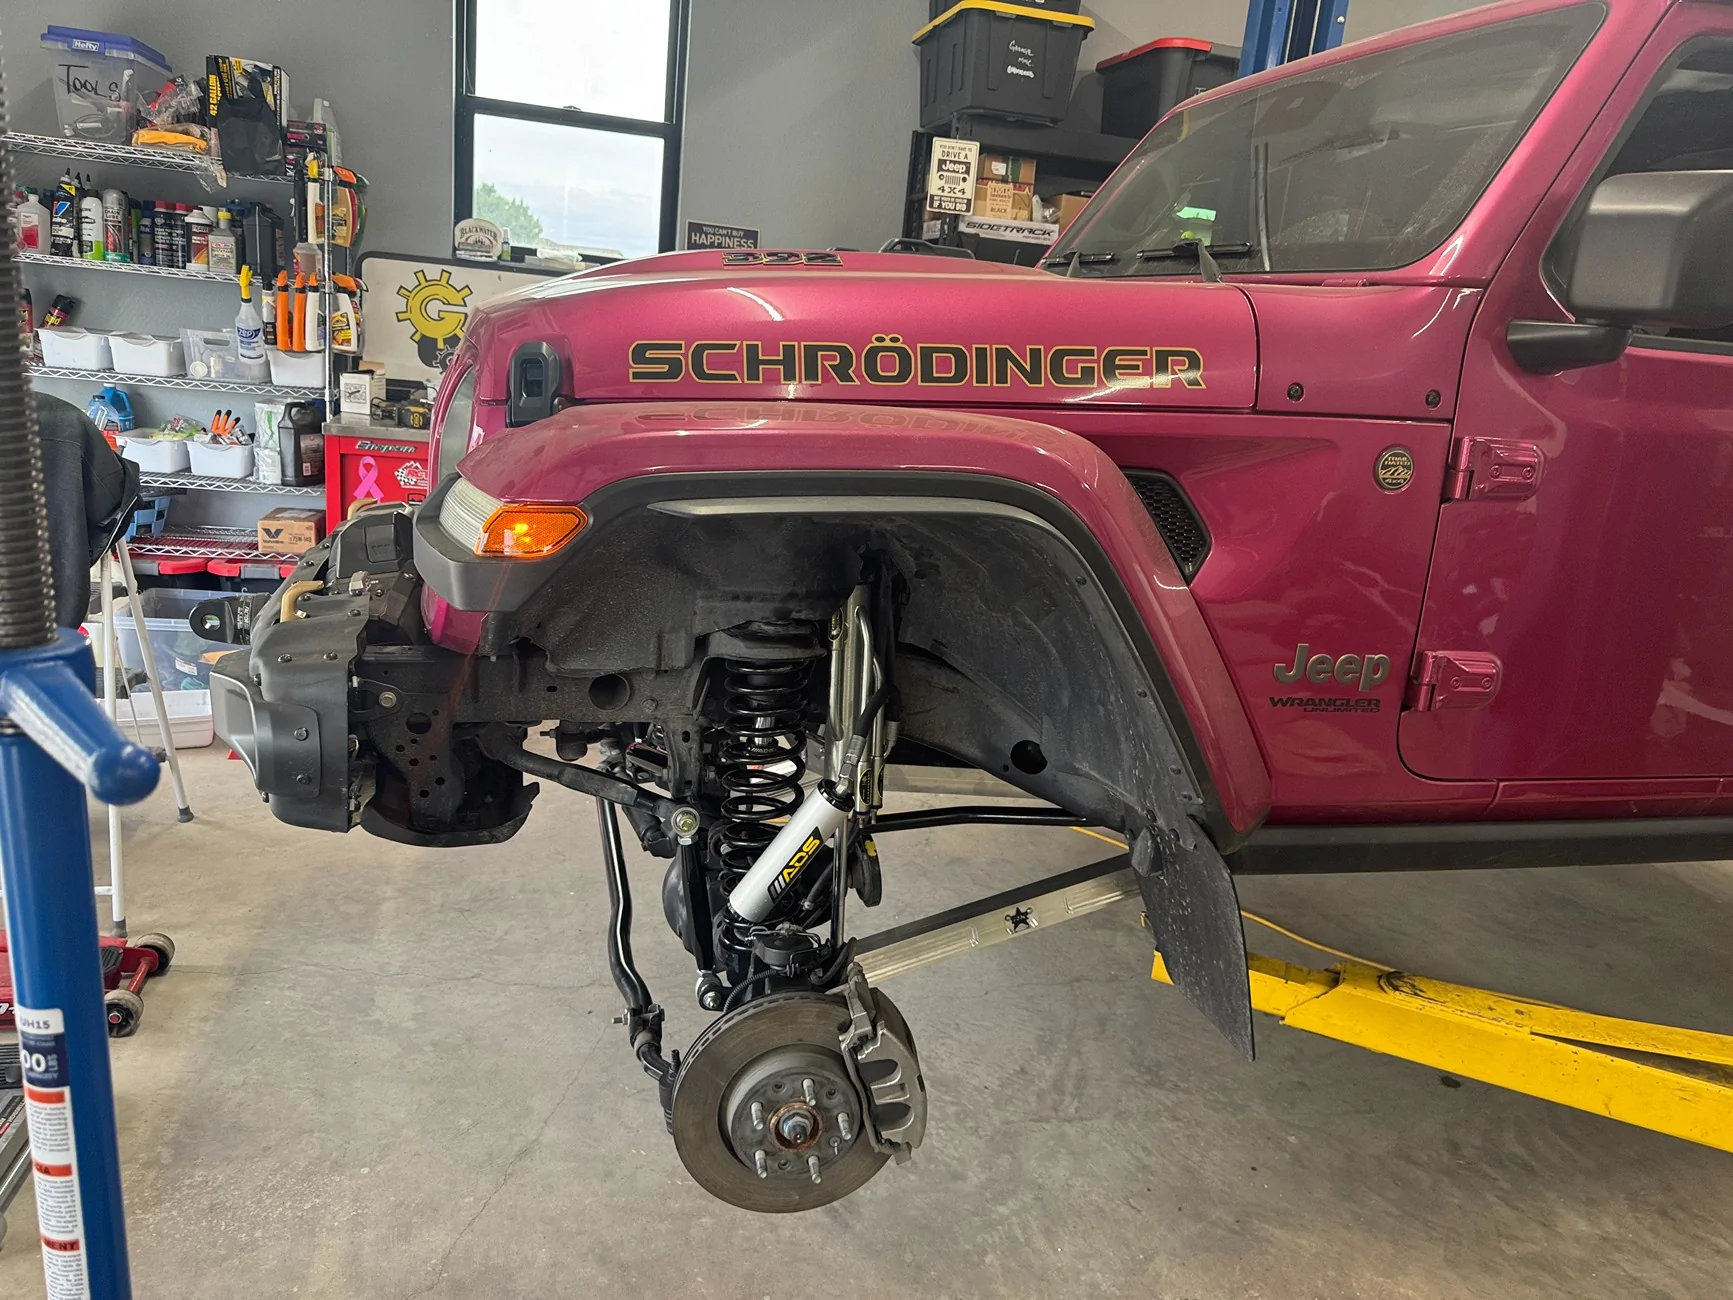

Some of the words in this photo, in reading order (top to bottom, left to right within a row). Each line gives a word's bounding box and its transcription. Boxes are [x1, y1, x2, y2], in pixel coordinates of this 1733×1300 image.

[74, 41, 98, 51] Hefty
[209, 74, 217, 104] GALLON
[209, 105, 218, 116] 42
[941, 150, 961, 160] DRIVE
[942, 160, 966, 173] Jeep
[933, 200, 940, 208] IF
[941, 201, 955, 210] YOU
[955, 203, 967, 211] DID
[702, 226, 714, 234] YOU
[714, 227, 731, 236] CAN'T
[732, 229, 744, 238] BUY
[965, 221, 1055, 237] SIDETRACK
[691, 233, 755, 250] HAPPINESS
[629, 333, 1207, 389] SCHRÖDINGER
[1273, 643, 1391, 692] Jeep
[1269, 696, 1381, 708] WRANGLER
[782, 835, 820, 883] ADS
